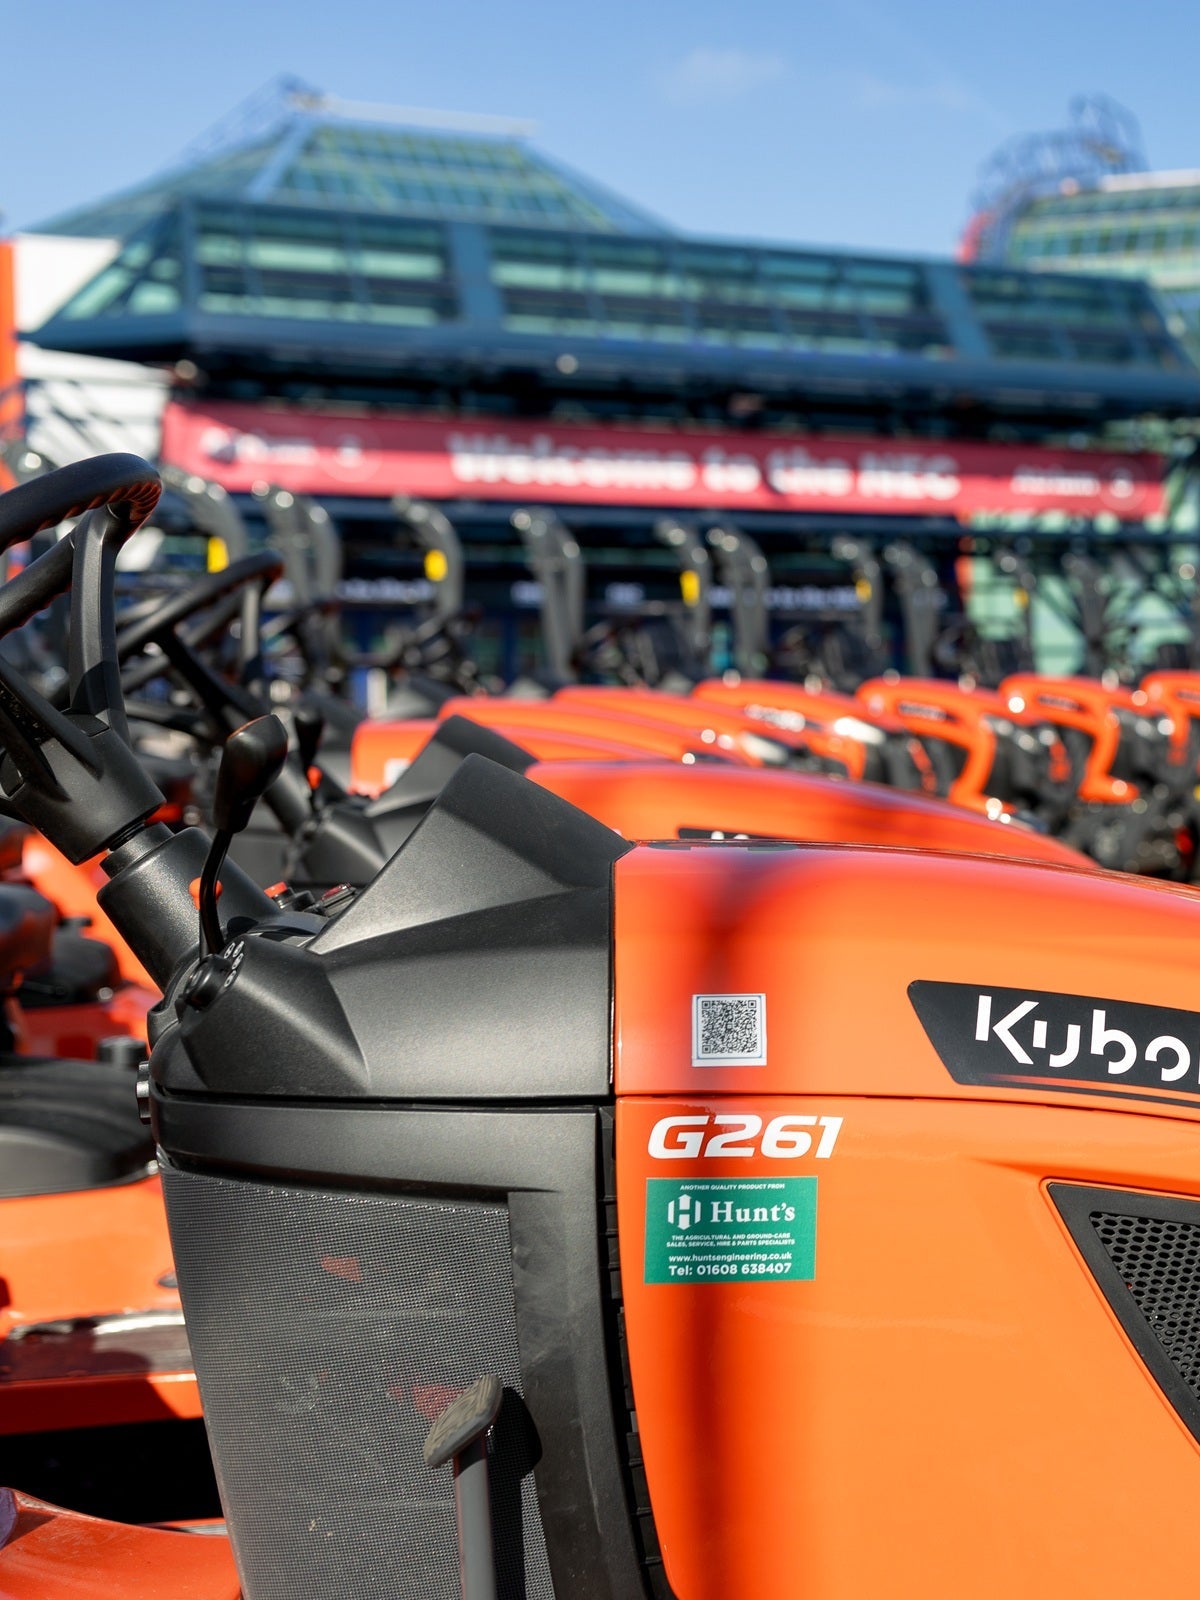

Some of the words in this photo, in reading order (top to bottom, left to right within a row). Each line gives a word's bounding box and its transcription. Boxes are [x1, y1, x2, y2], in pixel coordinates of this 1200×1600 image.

[447, 432, 697, 492] Welcome
[703, 446, 761, 494] to
[648, 1114, 844, 1159] G261
[710, 1201, 796, 1223] Hunt's
[746, 1232, 790, 1240] GROUND-CARE
[757, 1238, 795, 1246] SPECIALISTS
[668, 1251, 792, 1262] www.huntsengineering.co.uk
[668, 1264, 693, 1276] Tel:
[696, 1263, 738, 1276] 01608
[741, 1262, 792, 1275] 638407
